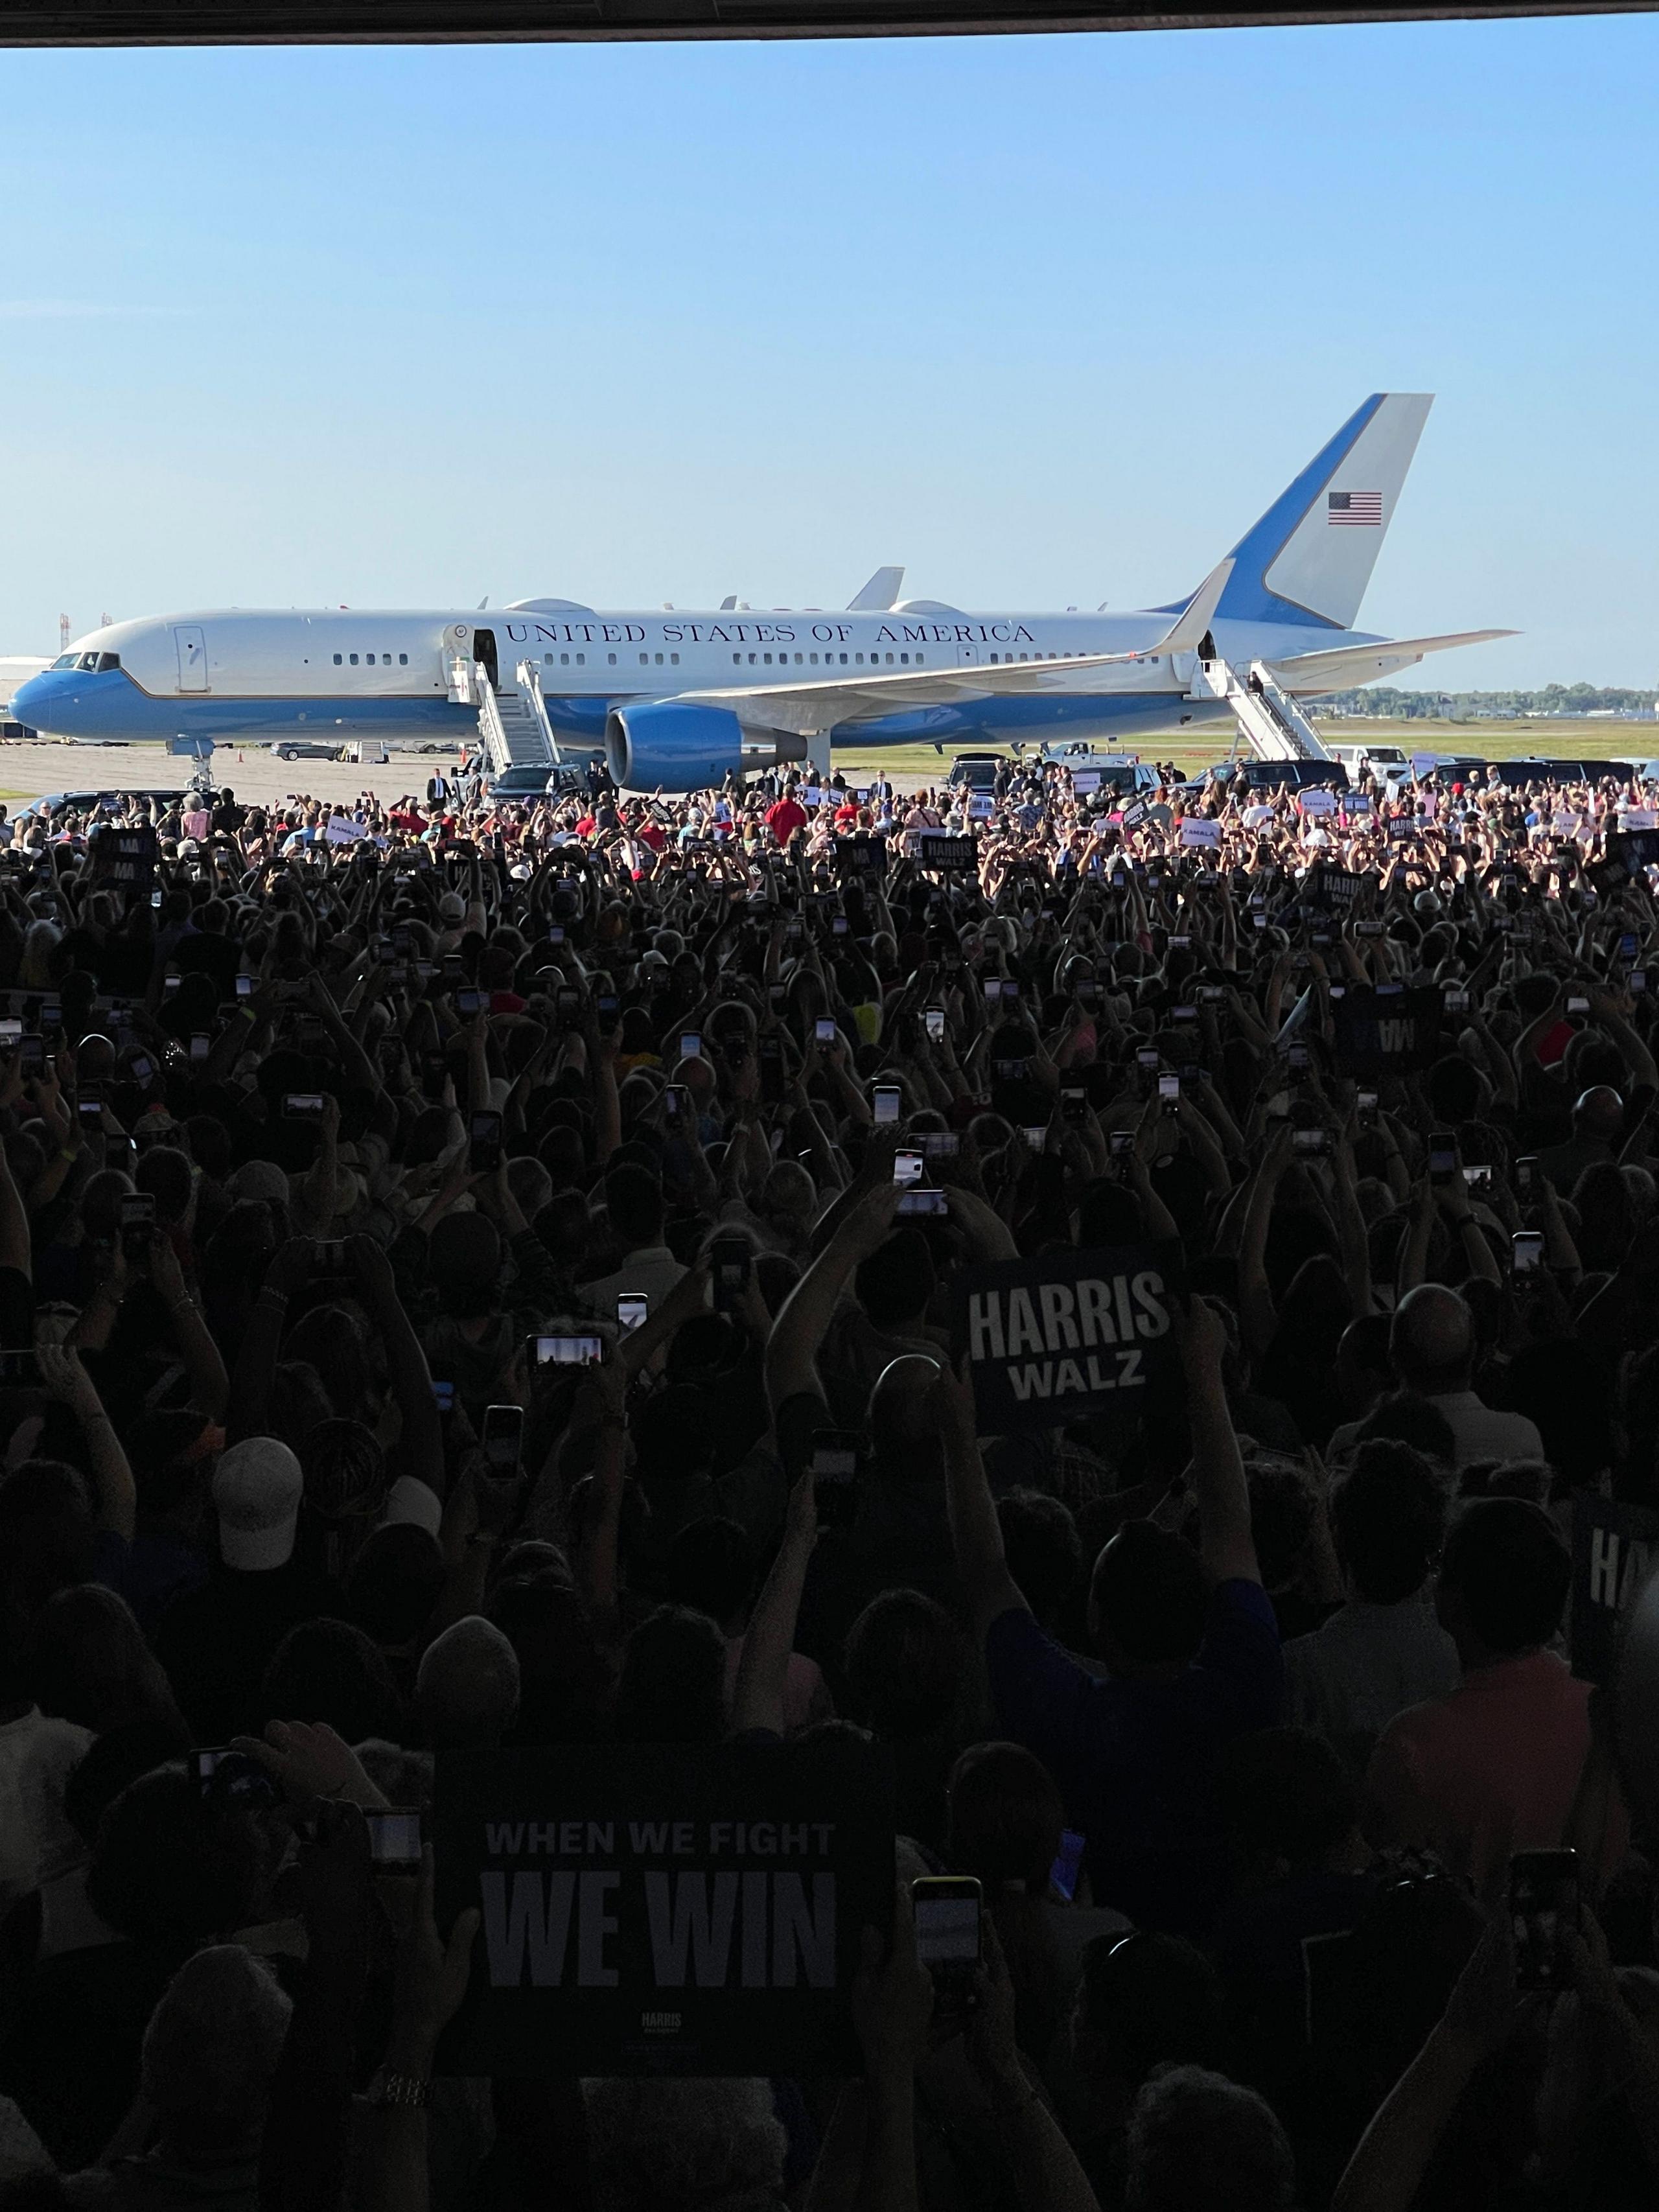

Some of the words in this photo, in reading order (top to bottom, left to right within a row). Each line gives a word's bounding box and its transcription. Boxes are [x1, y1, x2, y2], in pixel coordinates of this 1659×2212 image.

[505, 624, 645, 642] UNITED
[663, 624, 796, 642] STATES
[811, 624, 853, 642] OF
[876, 625, 1035, 642] AMERICA
[331, 825, 360, 837] KAMALA
[928, 841, 973, 857] HARRIS
[935, 857, 965, 867] WALZ
[969, 1270, 1170, 1361] HARRIS
[1006, 1349, 1146, 1401] WALZ
[485, 1821, 614, 1855] WHEN
[628, 1821, 695, 1855] WE
[710, 1822, 837, 1856] FIGHT
[480, 1870, 620, 1988] WE
[644, 1870, 837, 1988] WIN
[641, 2012, 682, 2027] HARRIS
